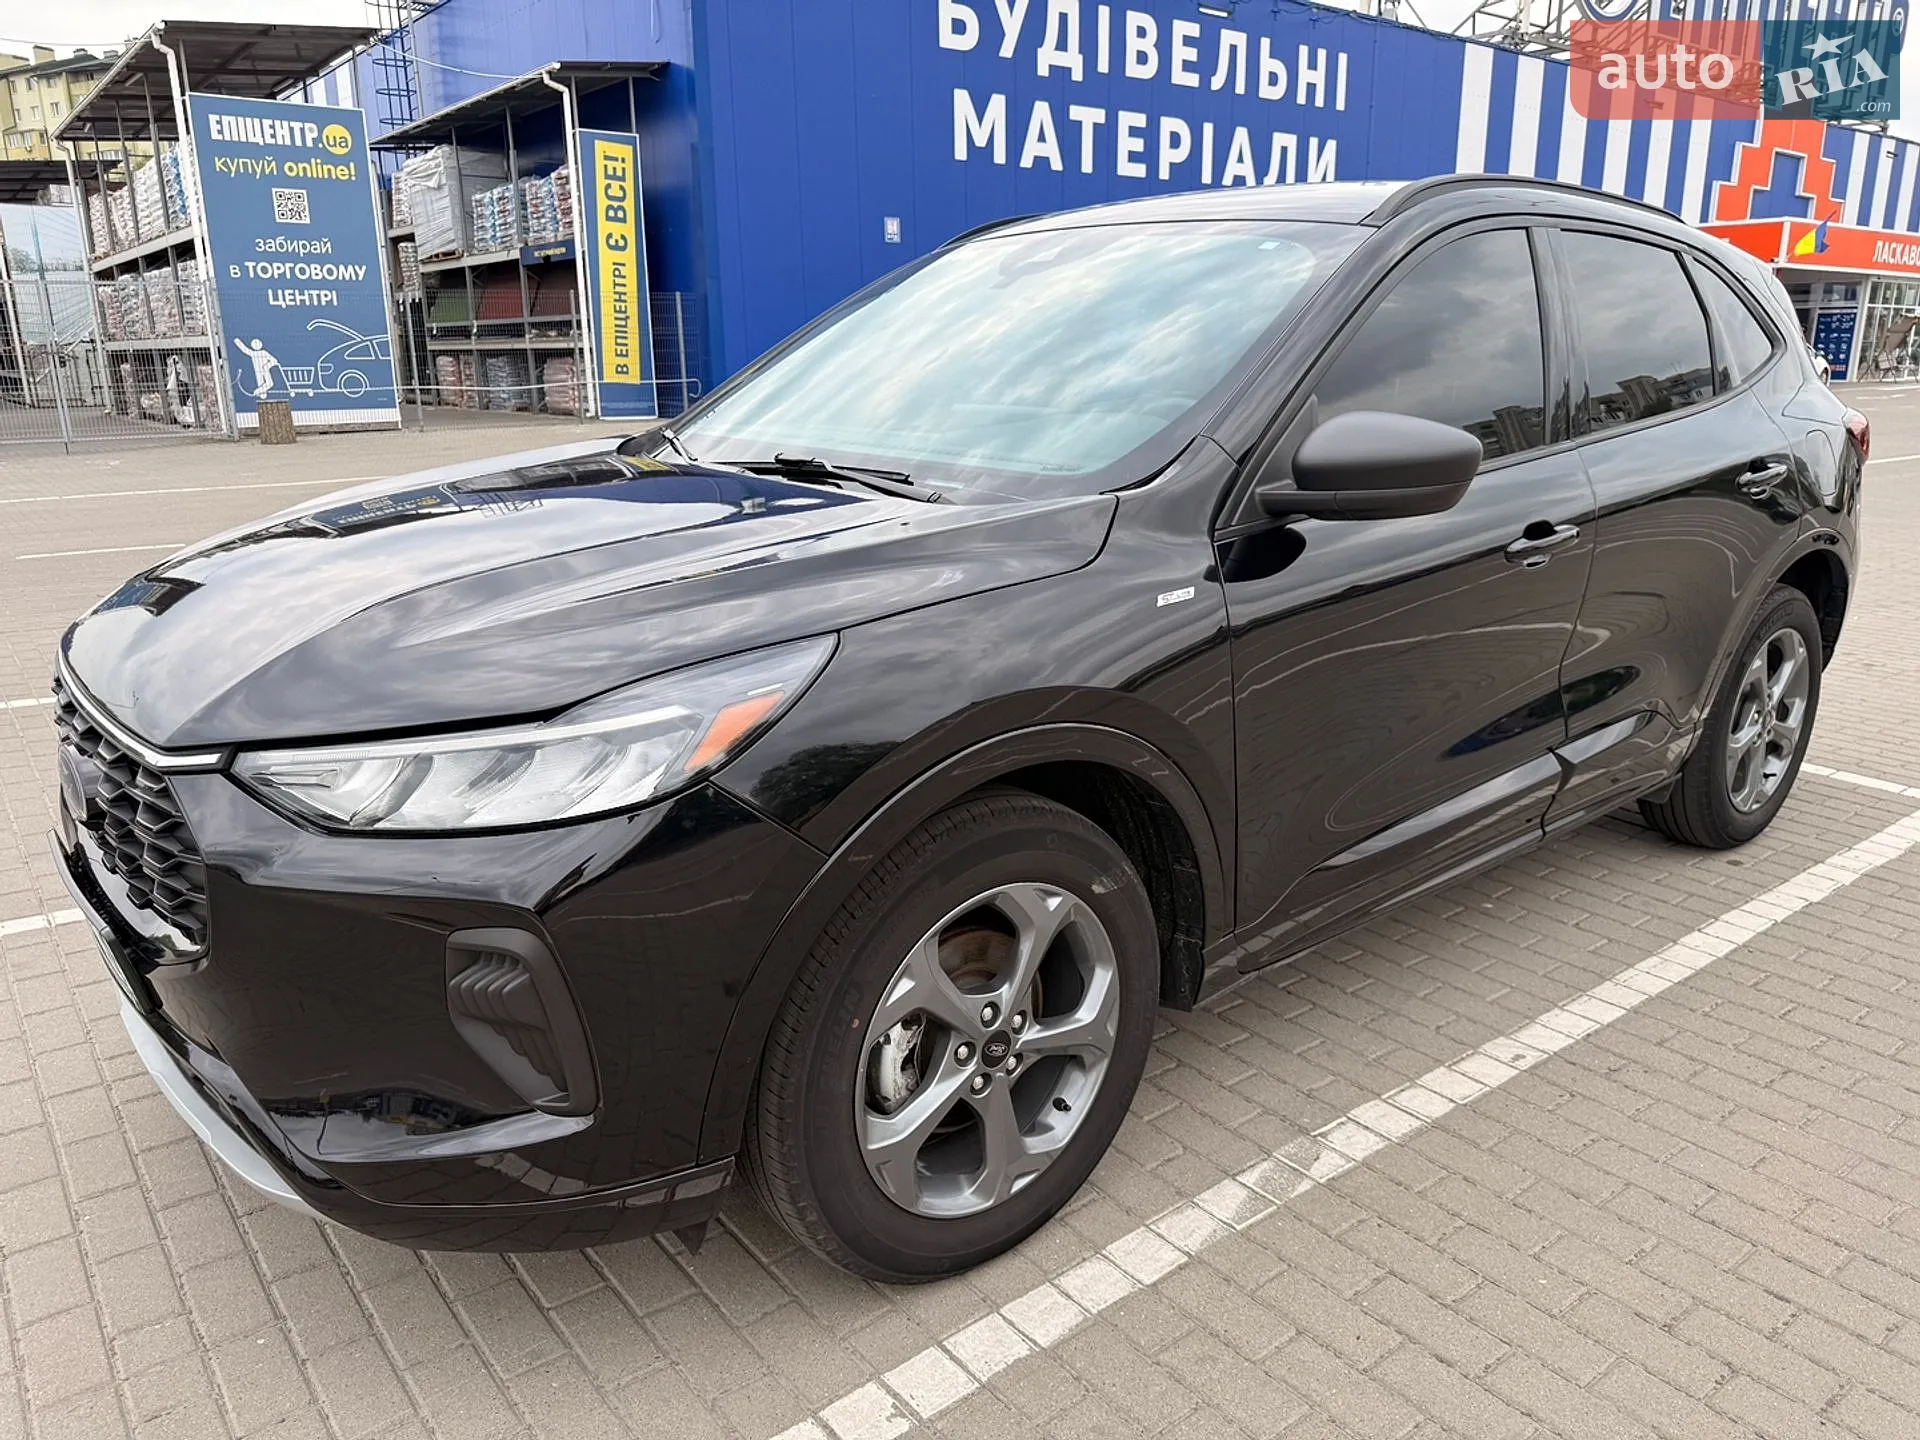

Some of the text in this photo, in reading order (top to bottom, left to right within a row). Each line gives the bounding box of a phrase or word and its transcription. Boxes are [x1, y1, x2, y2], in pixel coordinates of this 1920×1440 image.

[938, 0, 1347, 111] БУДІВЕЛЬНІ
[953, 88, 1336, 187] МАТЕРІАЛИ
[214, 156, 356, 181] купуй online!
[255, 236, 332, 257] забирай
[244, 261, 367, 281] ТОРГОВОМУ
[602, 150, 630, 376] В ЕПІЦЕНТРІ Є ВСЕ!
[267, 288, 337, 309] ЦЕНТРІ
